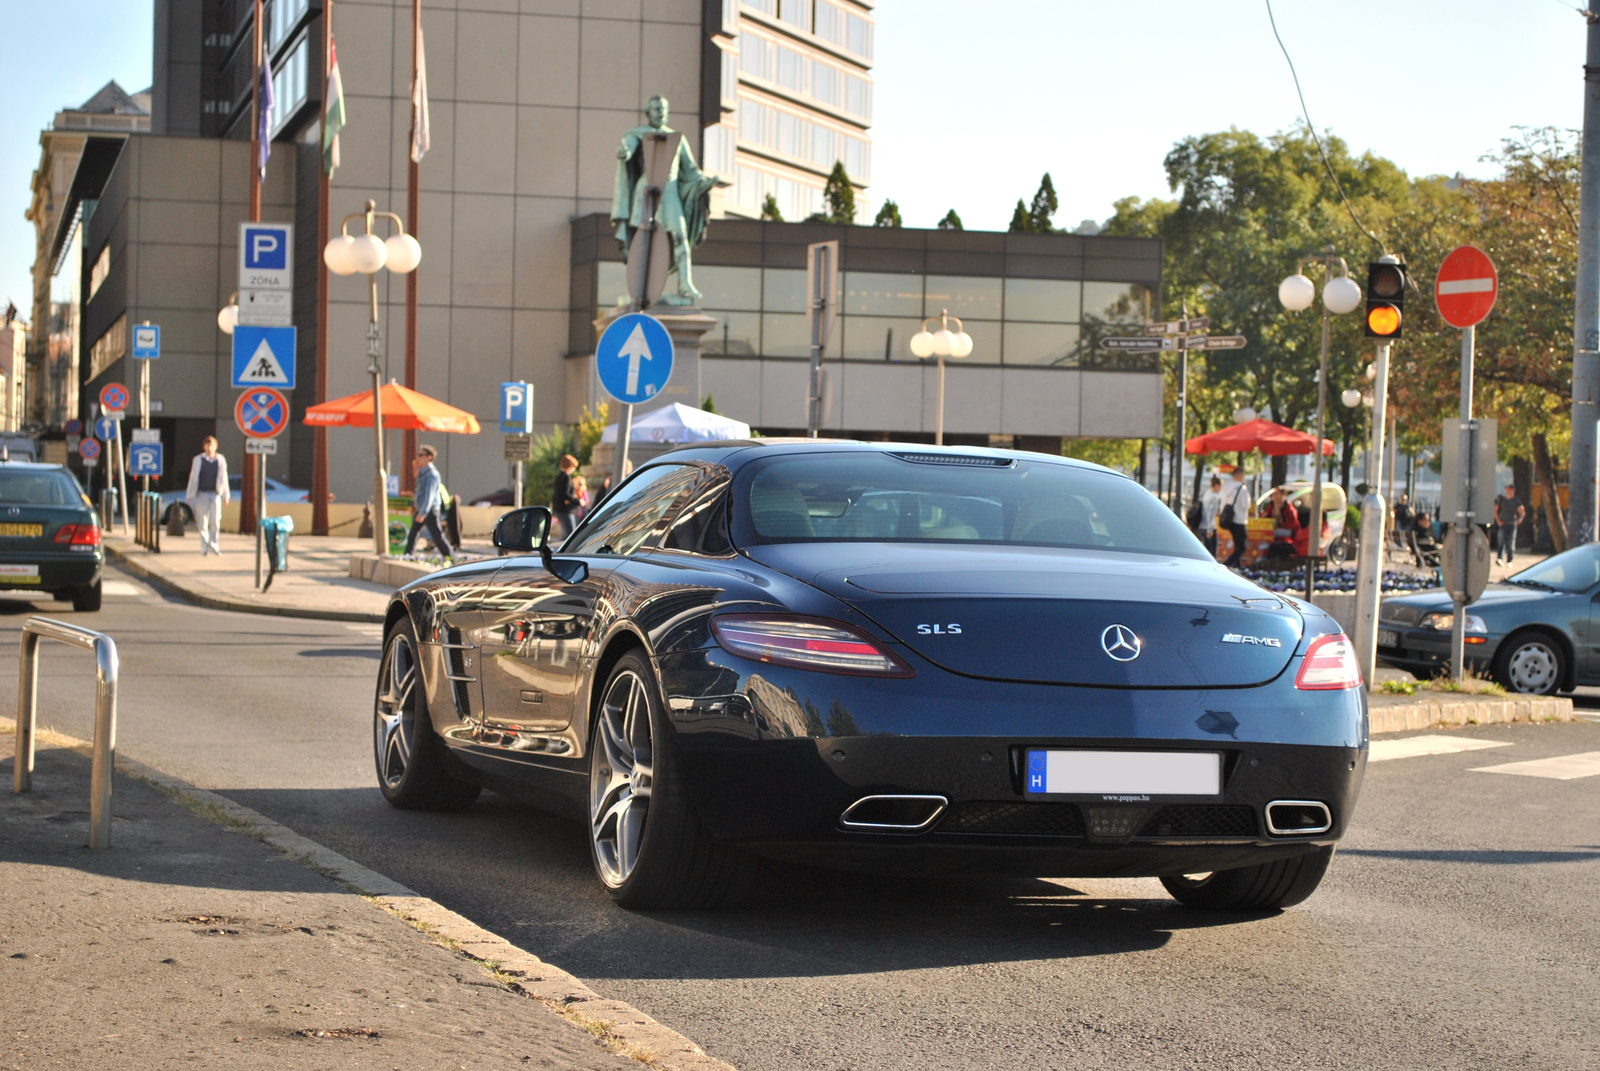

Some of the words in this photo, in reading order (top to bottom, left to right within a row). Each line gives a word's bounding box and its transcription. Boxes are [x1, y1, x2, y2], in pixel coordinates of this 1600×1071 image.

[253, 234, 278, 263] P
[506, 390, 523, 420] P
[138, 452, 153, 471] P
[917, 623, 962, 635] SLS
[1241, 635, 1281, 648] AMG
[1032, 775, 1041, 787] H
[1102, 793, 1150, 803] www.pappas.hu
